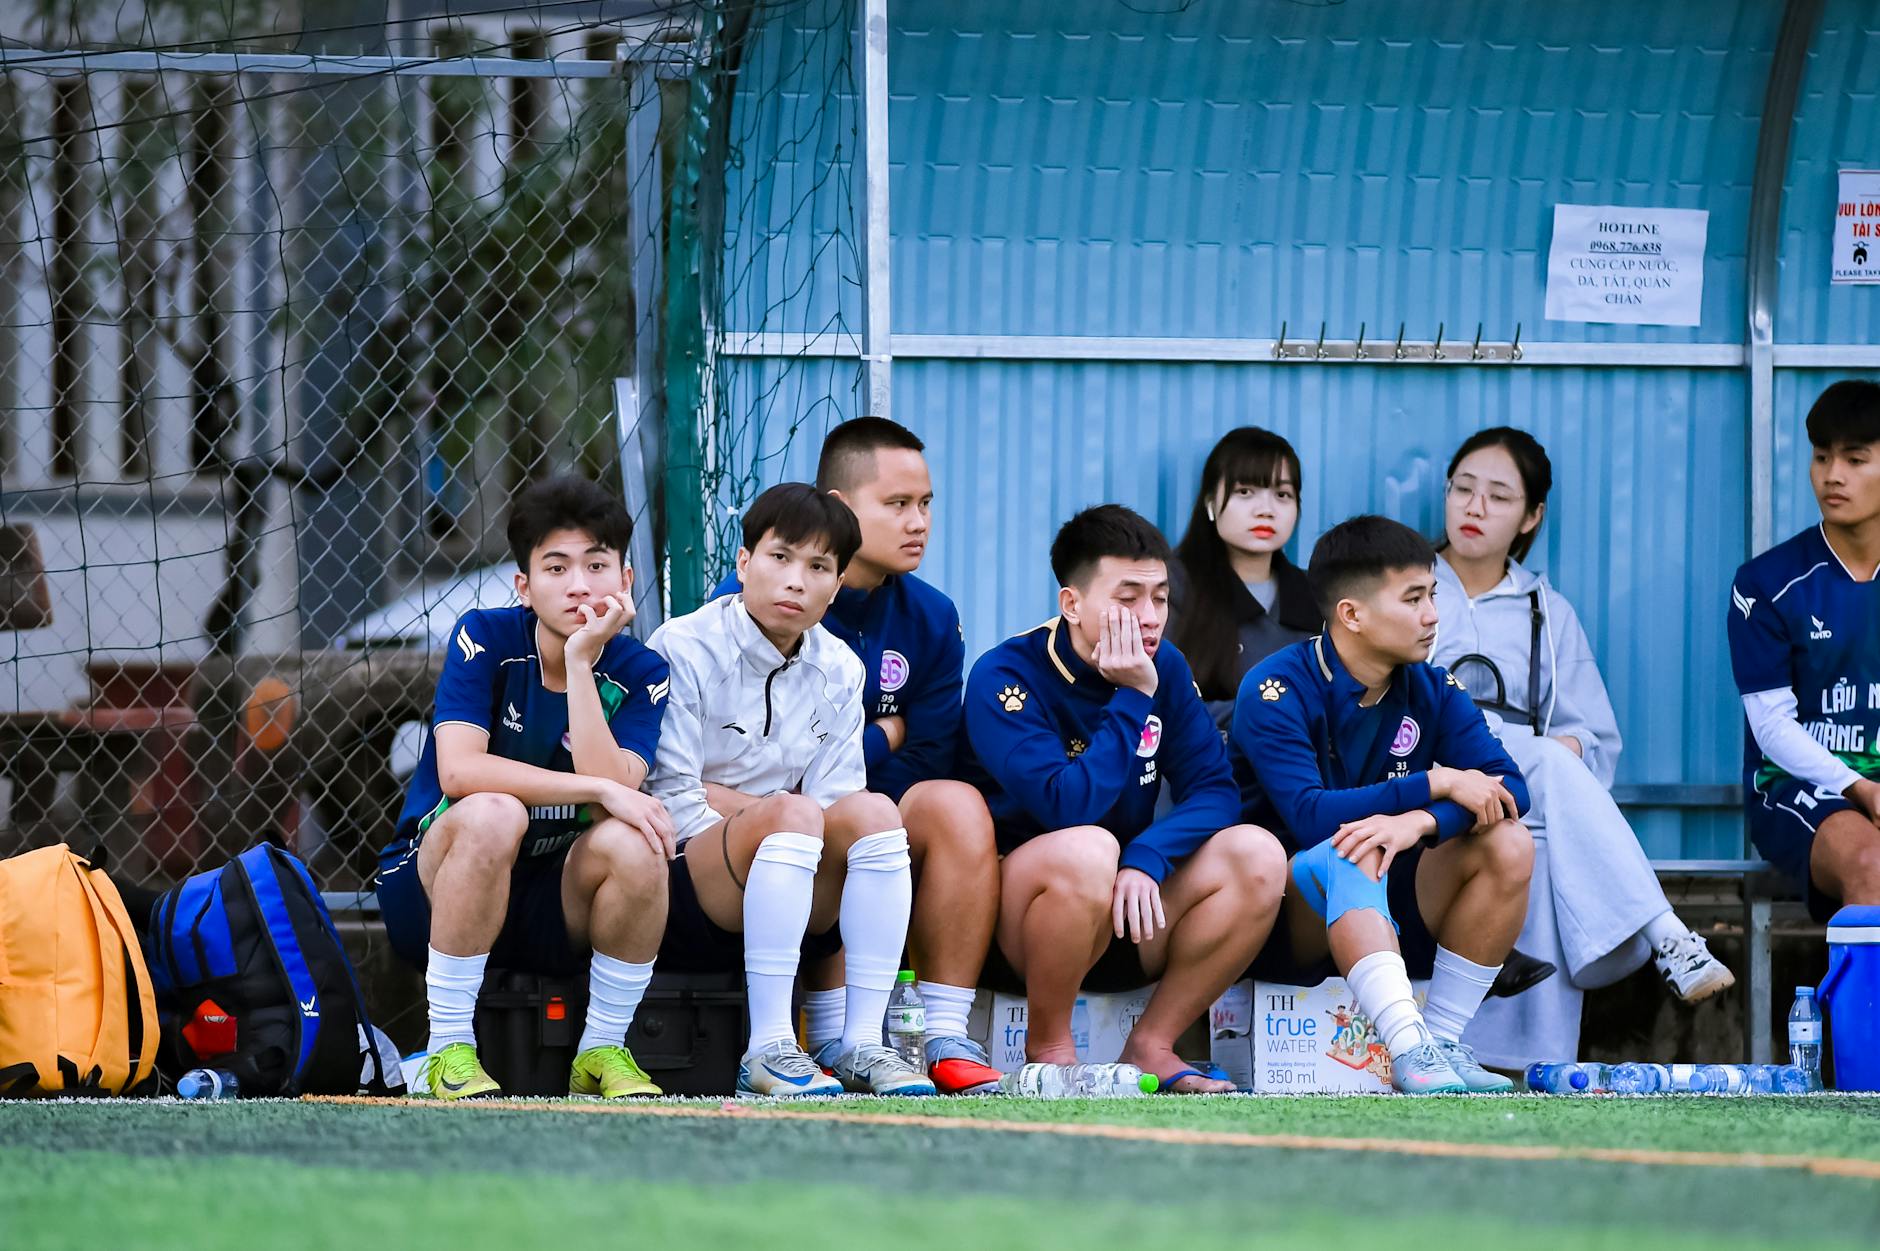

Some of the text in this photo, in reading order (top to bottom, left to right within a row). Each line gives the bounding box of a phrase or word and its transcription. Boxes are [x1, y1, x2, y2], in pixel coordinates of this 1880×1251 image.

[1599, 222, 1660, 235] HOTLINE
[1853, 221, 1870, 237] TÀI
[1570, 257, 1606, 270] CUNG
[881, 694, 894, 703] 99
[1822, 677, 1856, 714] LẨU
[1145, 760, 1155, 772] 88
[1396, 761, 1407, 771] 33
[1266, 994, 1296, 1011] TH
[1265, 1012, 1316, 1036] true
[1266, 1039, 1317, 1053] WATER
[1004, 1050, 1024, 1063] WA
[1267, 1069, 1293, 1084] 350
[1297, 1069, 1316, 1084] ml
